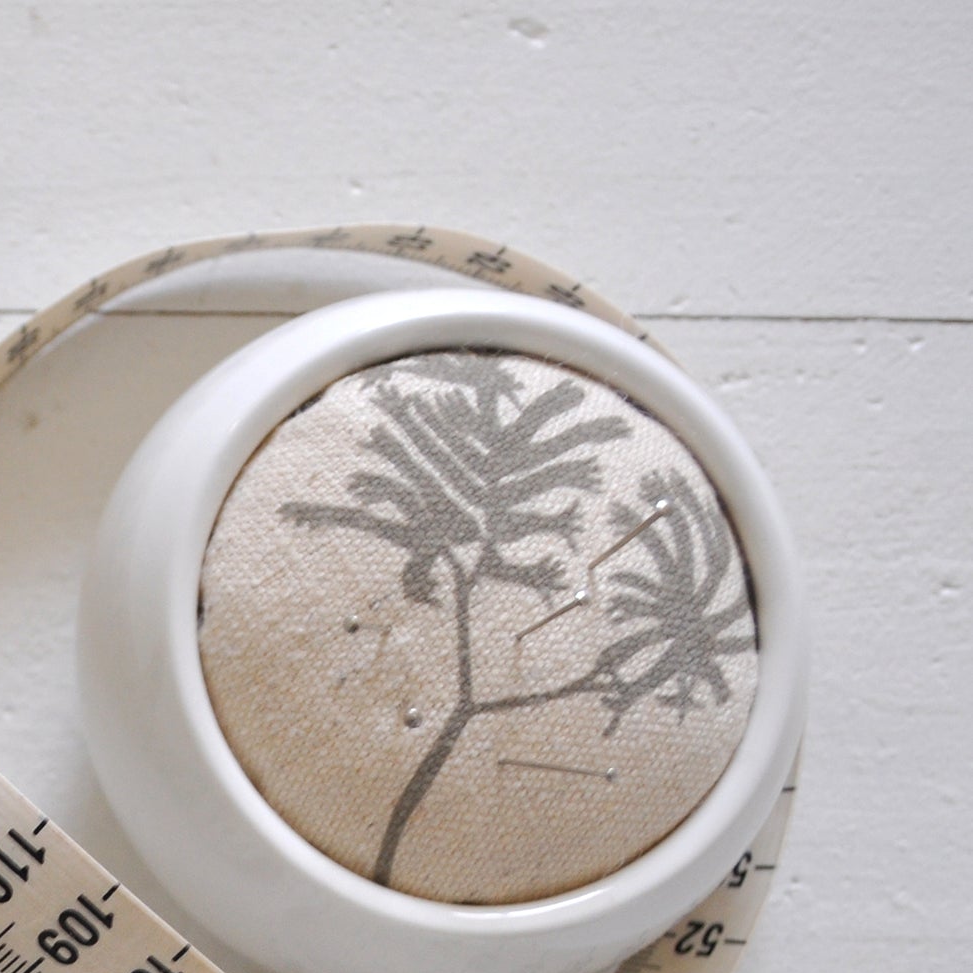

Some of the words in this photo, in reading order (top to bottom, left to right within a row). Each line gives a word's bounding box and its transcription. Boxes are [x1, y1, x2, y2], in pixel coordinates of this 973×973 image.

[726, 850, 752, 888] 5
[37, 894, 115, 965] 109
[674, 920, 723, 957] 52
